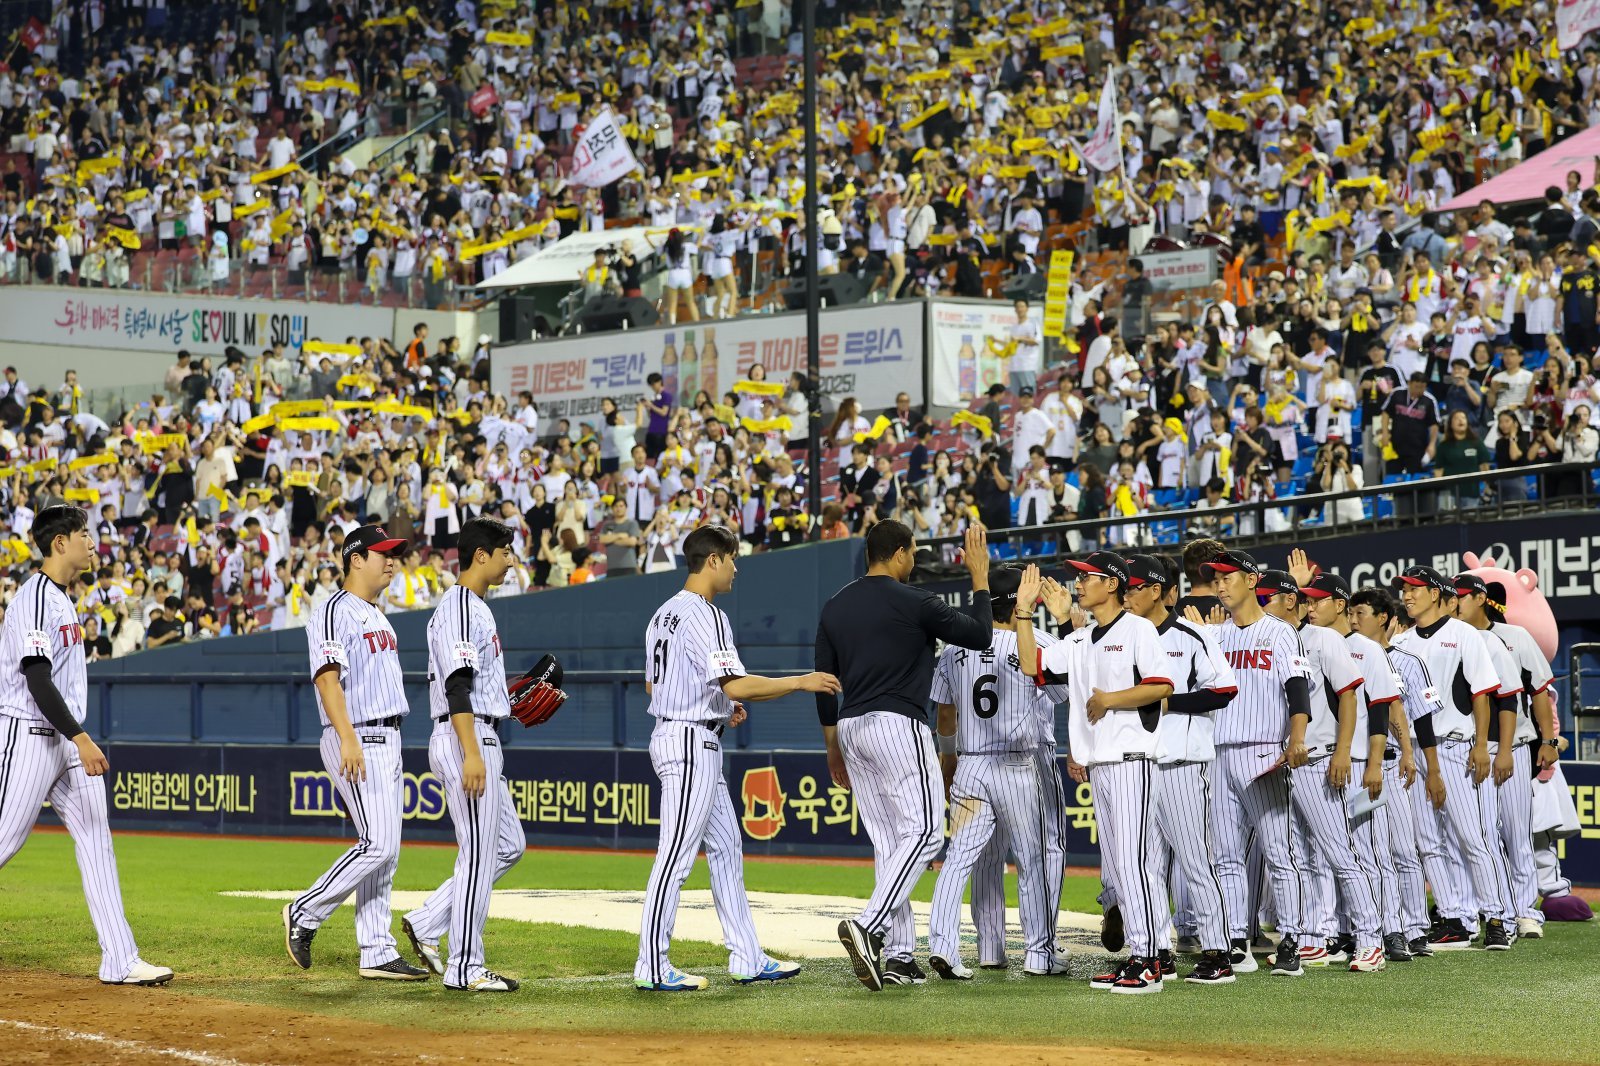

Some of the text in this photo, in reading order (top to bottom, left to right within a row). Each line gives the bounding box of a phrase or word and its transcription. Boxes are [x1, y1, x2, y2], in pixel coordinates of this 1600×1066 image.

[159, 309, 190, 345] 서울
[736, 341, 756, 375] 큰
[843, 328, 903, 366] 트윈스
[510, 352, 647, 397] 큰 피로엔 구론산
[653, 638, 669, 685] 61
[1104, 644, 1124, 653] TWINS
[972, 673, 999, 719] 6
[113, 771, 257, 813] 상쾌함엔 언제나
[290, 770, 447, 821] mos
